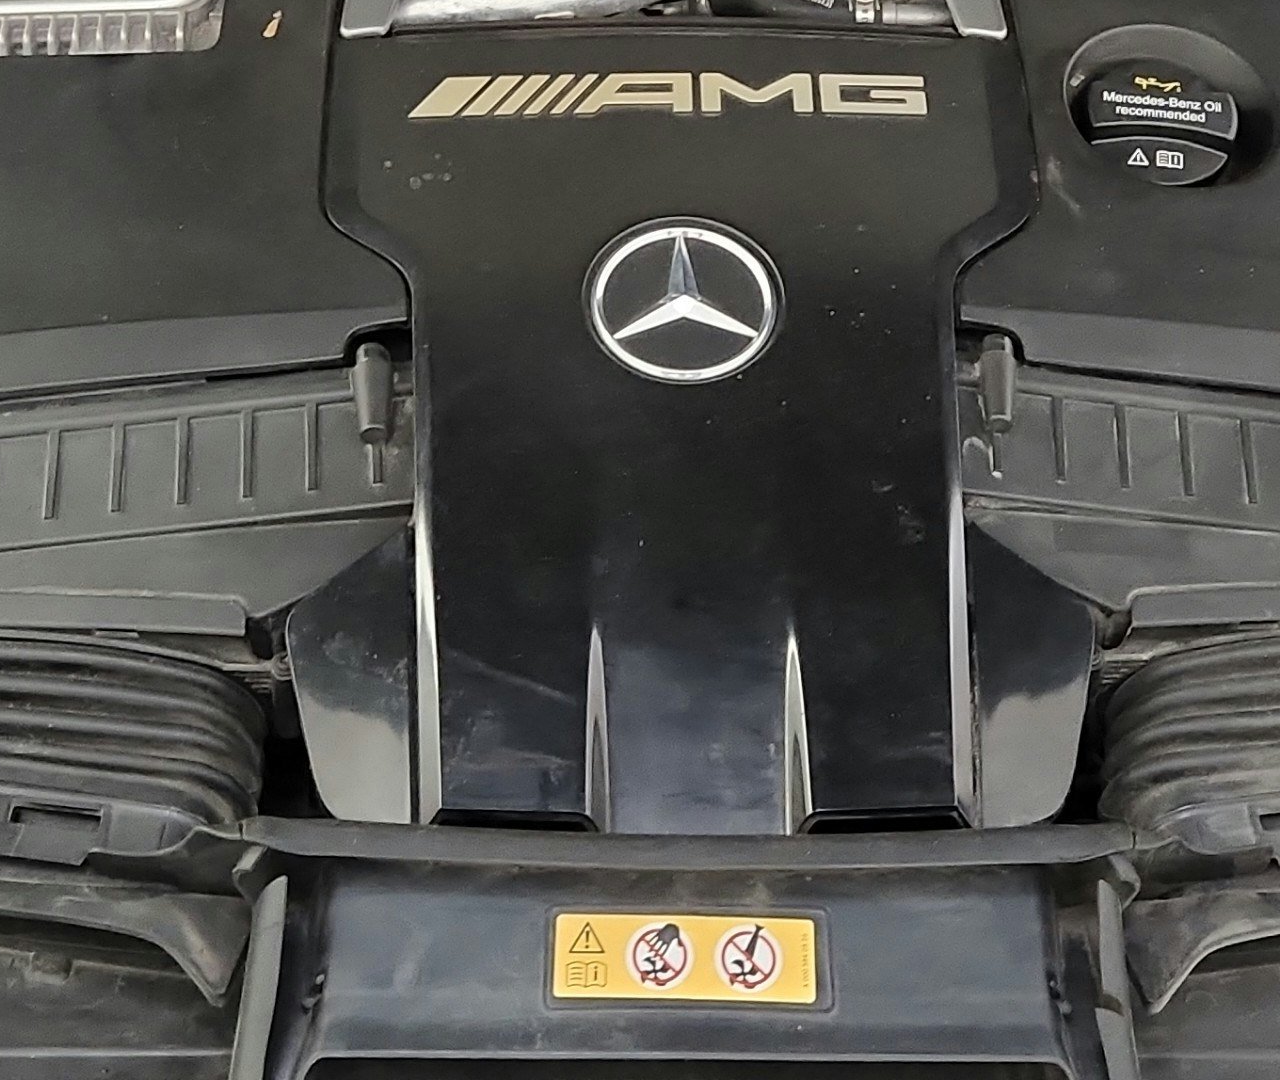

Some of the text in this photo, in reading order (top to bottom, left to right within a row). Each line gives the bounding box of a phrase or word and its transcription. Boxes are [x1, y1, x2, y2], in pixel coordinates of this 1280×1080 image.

[574, 72, 928, 115] AMG
[1102, 90, 1222, 113] Mercedes-Benz Oil
[1115, 105, 1206, 123] recommended
